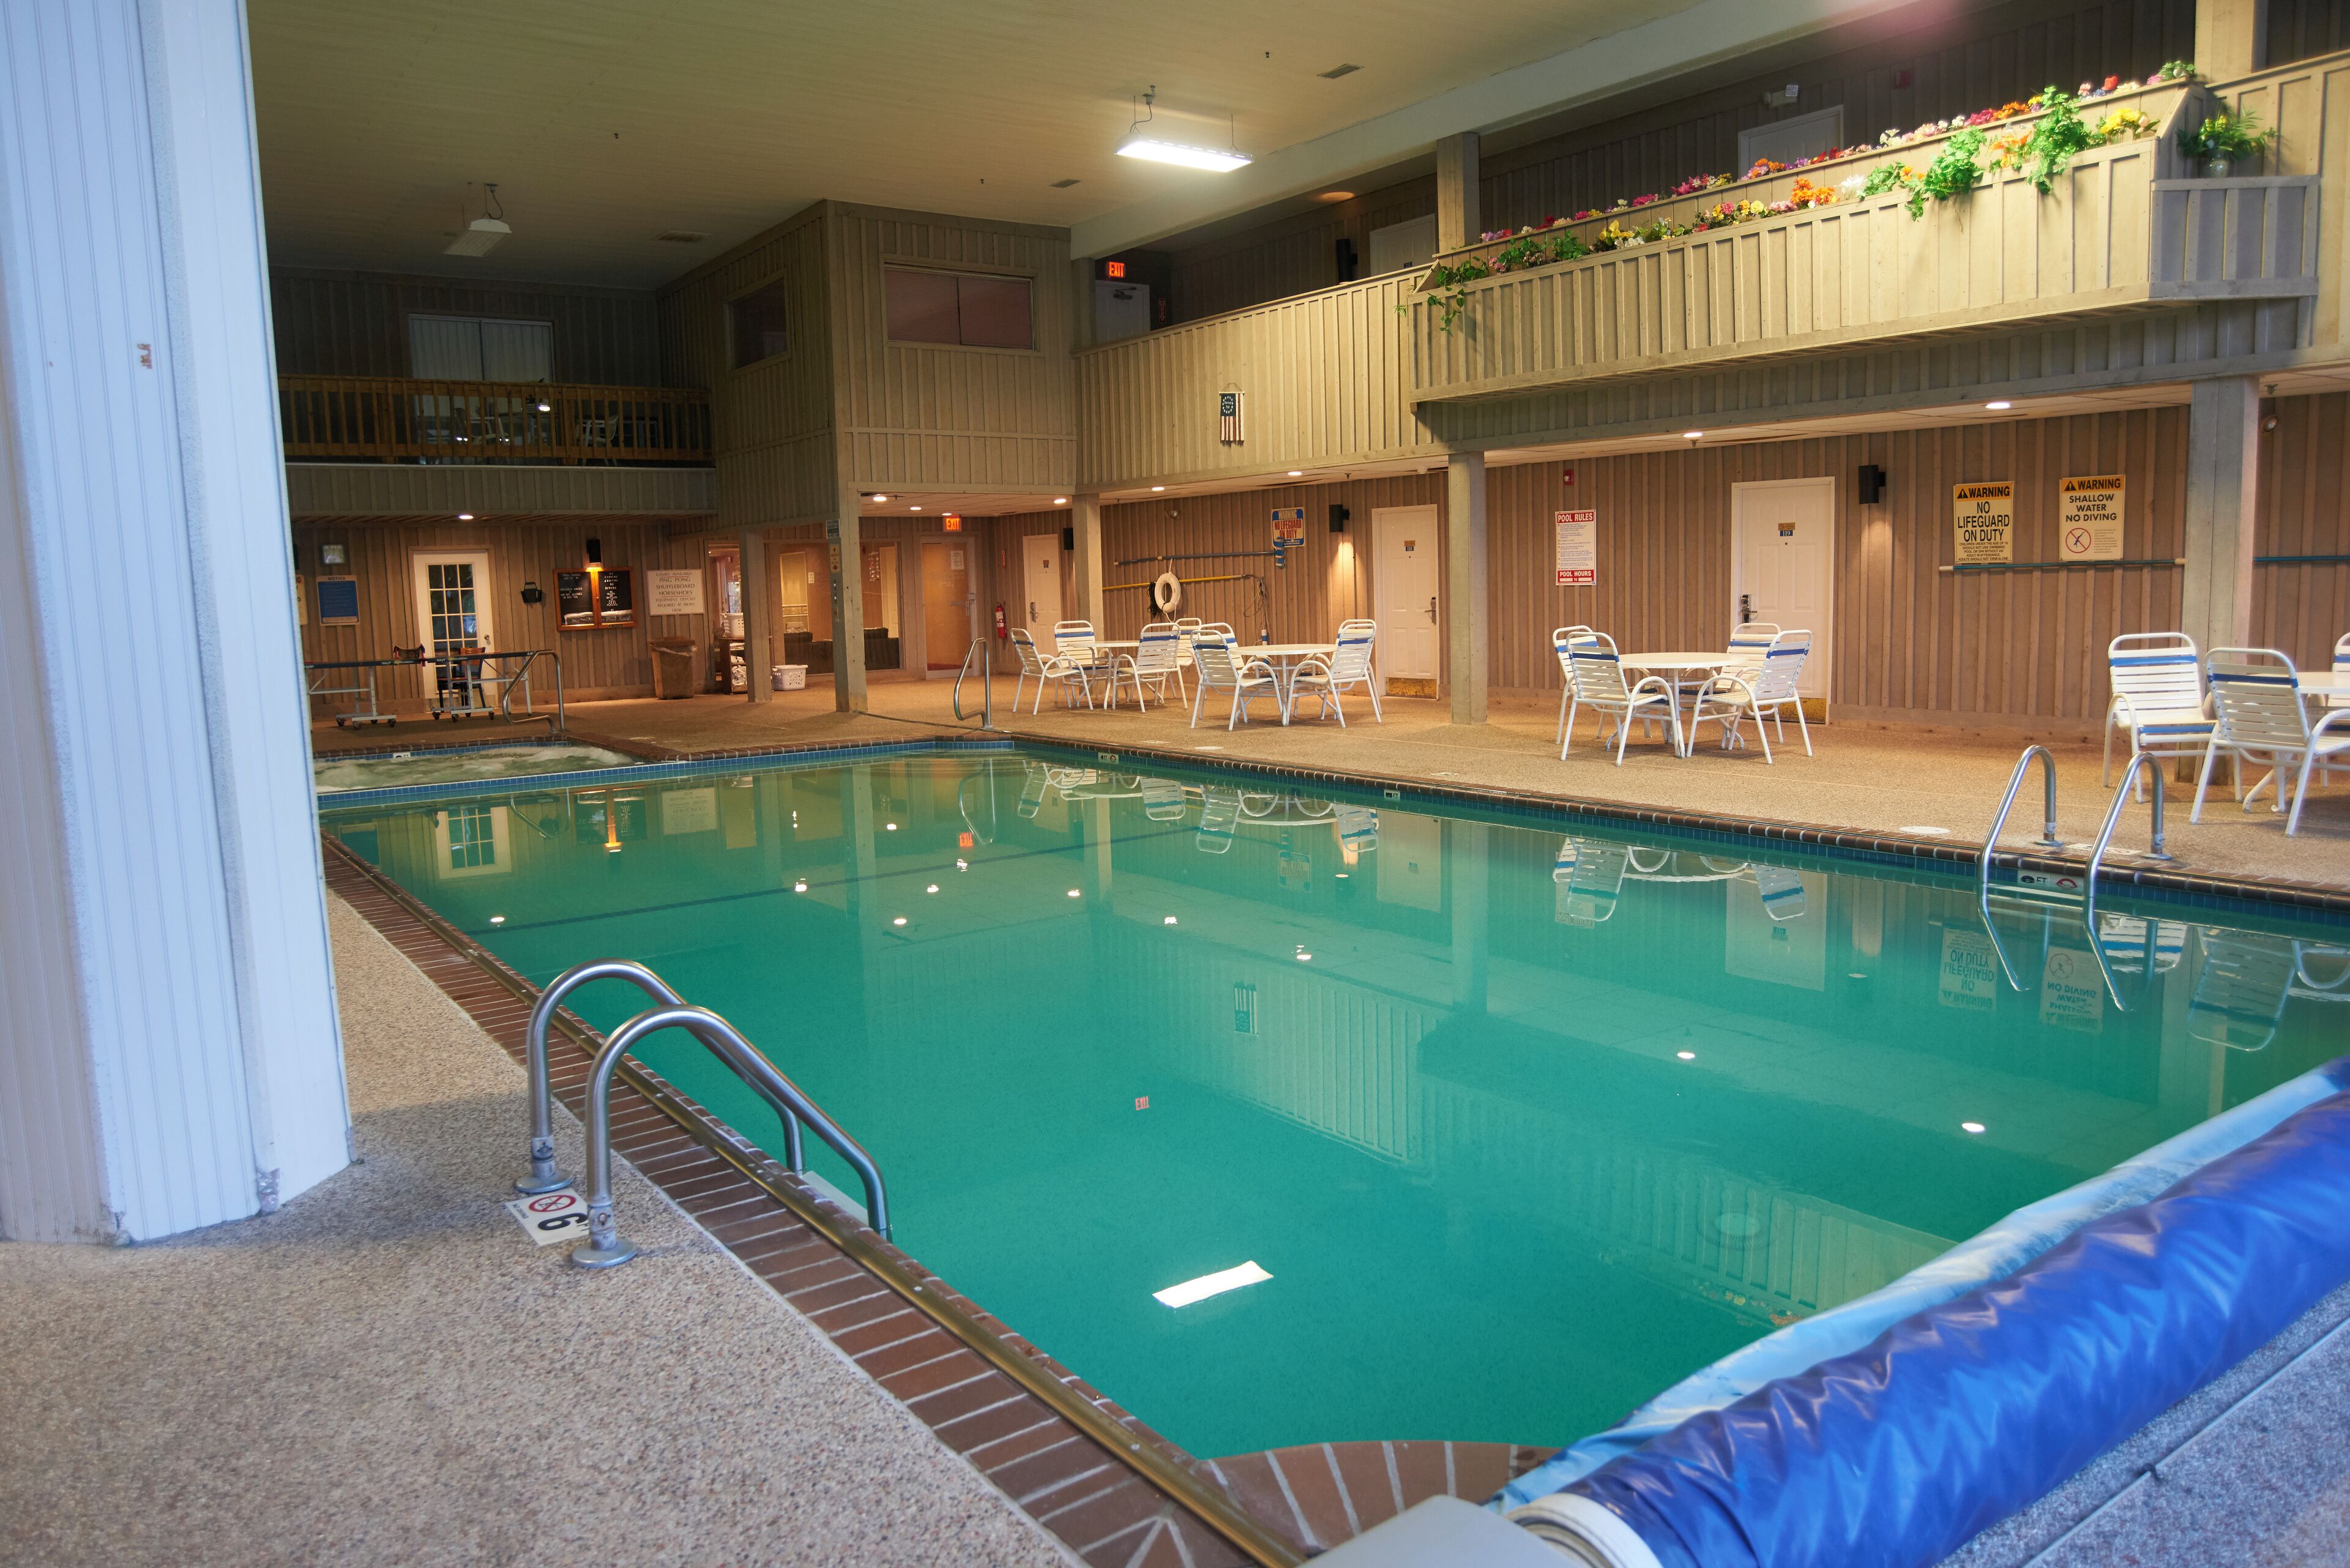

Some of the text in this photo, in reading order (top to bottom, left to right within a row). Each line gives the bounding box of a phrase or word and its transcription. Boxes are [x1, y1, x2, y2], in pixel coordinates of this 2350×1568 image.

[1109, 262, 1124, 277] EXIT
[2077, 478, 2121, 490] WARNING
[1968, 486, 2010, 498] WARNING
[2069, 493, 2114, 503] SHALLOW
[1977, 501, 1990, 514] NO
[2076, 504, 2106, 512] WATER
[1278, 509, 1297, 520] WARNING
[1557, 513, 1593, 523] POOL RULES
[2083, 513, 2117, 521] DIVING
[946, 518, 960, 530] EXIT
[1274, 519, 1302, 530] NO LIFEGUARD
[1958, 514, 2010, 529] LIFEGUARD
[1279, 529, 1297, 539] ON DUTY
[1963, 528, 2004, 542] ON DUTY
[2037, 876, 2046, 885] FT
[517, 1208, 529, 1219] DIVING
